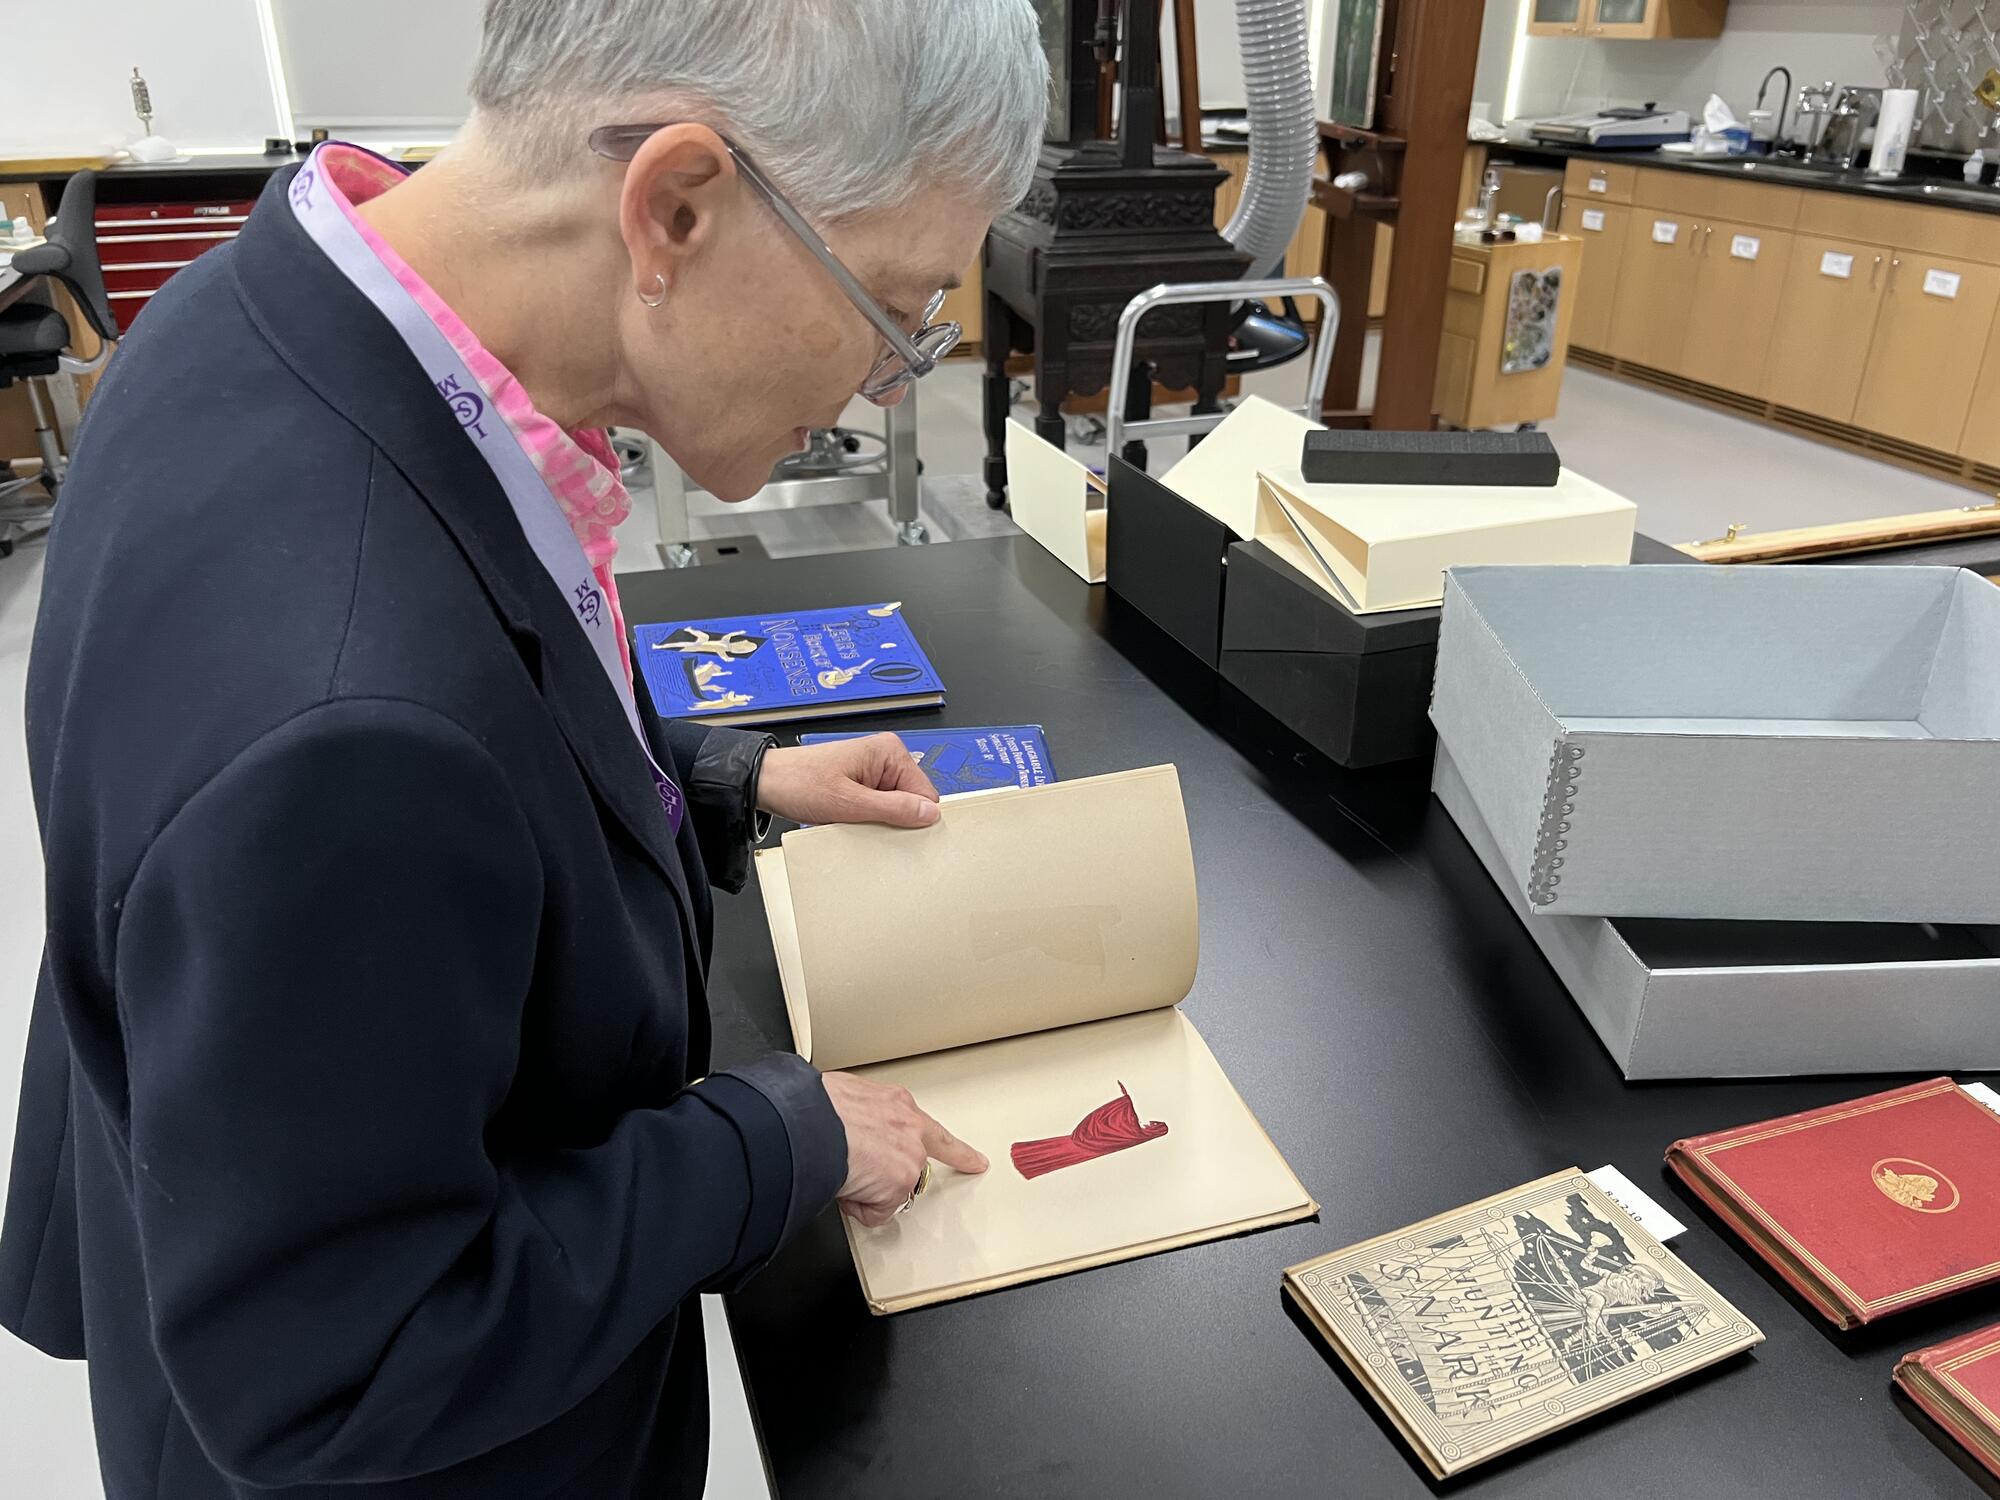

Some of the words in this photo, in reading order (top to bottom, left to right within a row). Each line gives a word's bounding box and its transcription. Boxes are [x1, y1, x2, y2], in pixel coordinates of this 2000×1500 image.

[760, 619, 818, 697] NONSENSE
[1021, 740, 1044, 775] LAUGHABLE
[1378, 1263, 1498, 1419] SNARK
[1448, 1266, 1539, 1389] HUNTING
[1449, 1296, 1468, 1313] OF
[1478, 1342, 1504, 1377] THE
[1500, 1299, 1541, 1351] THE
